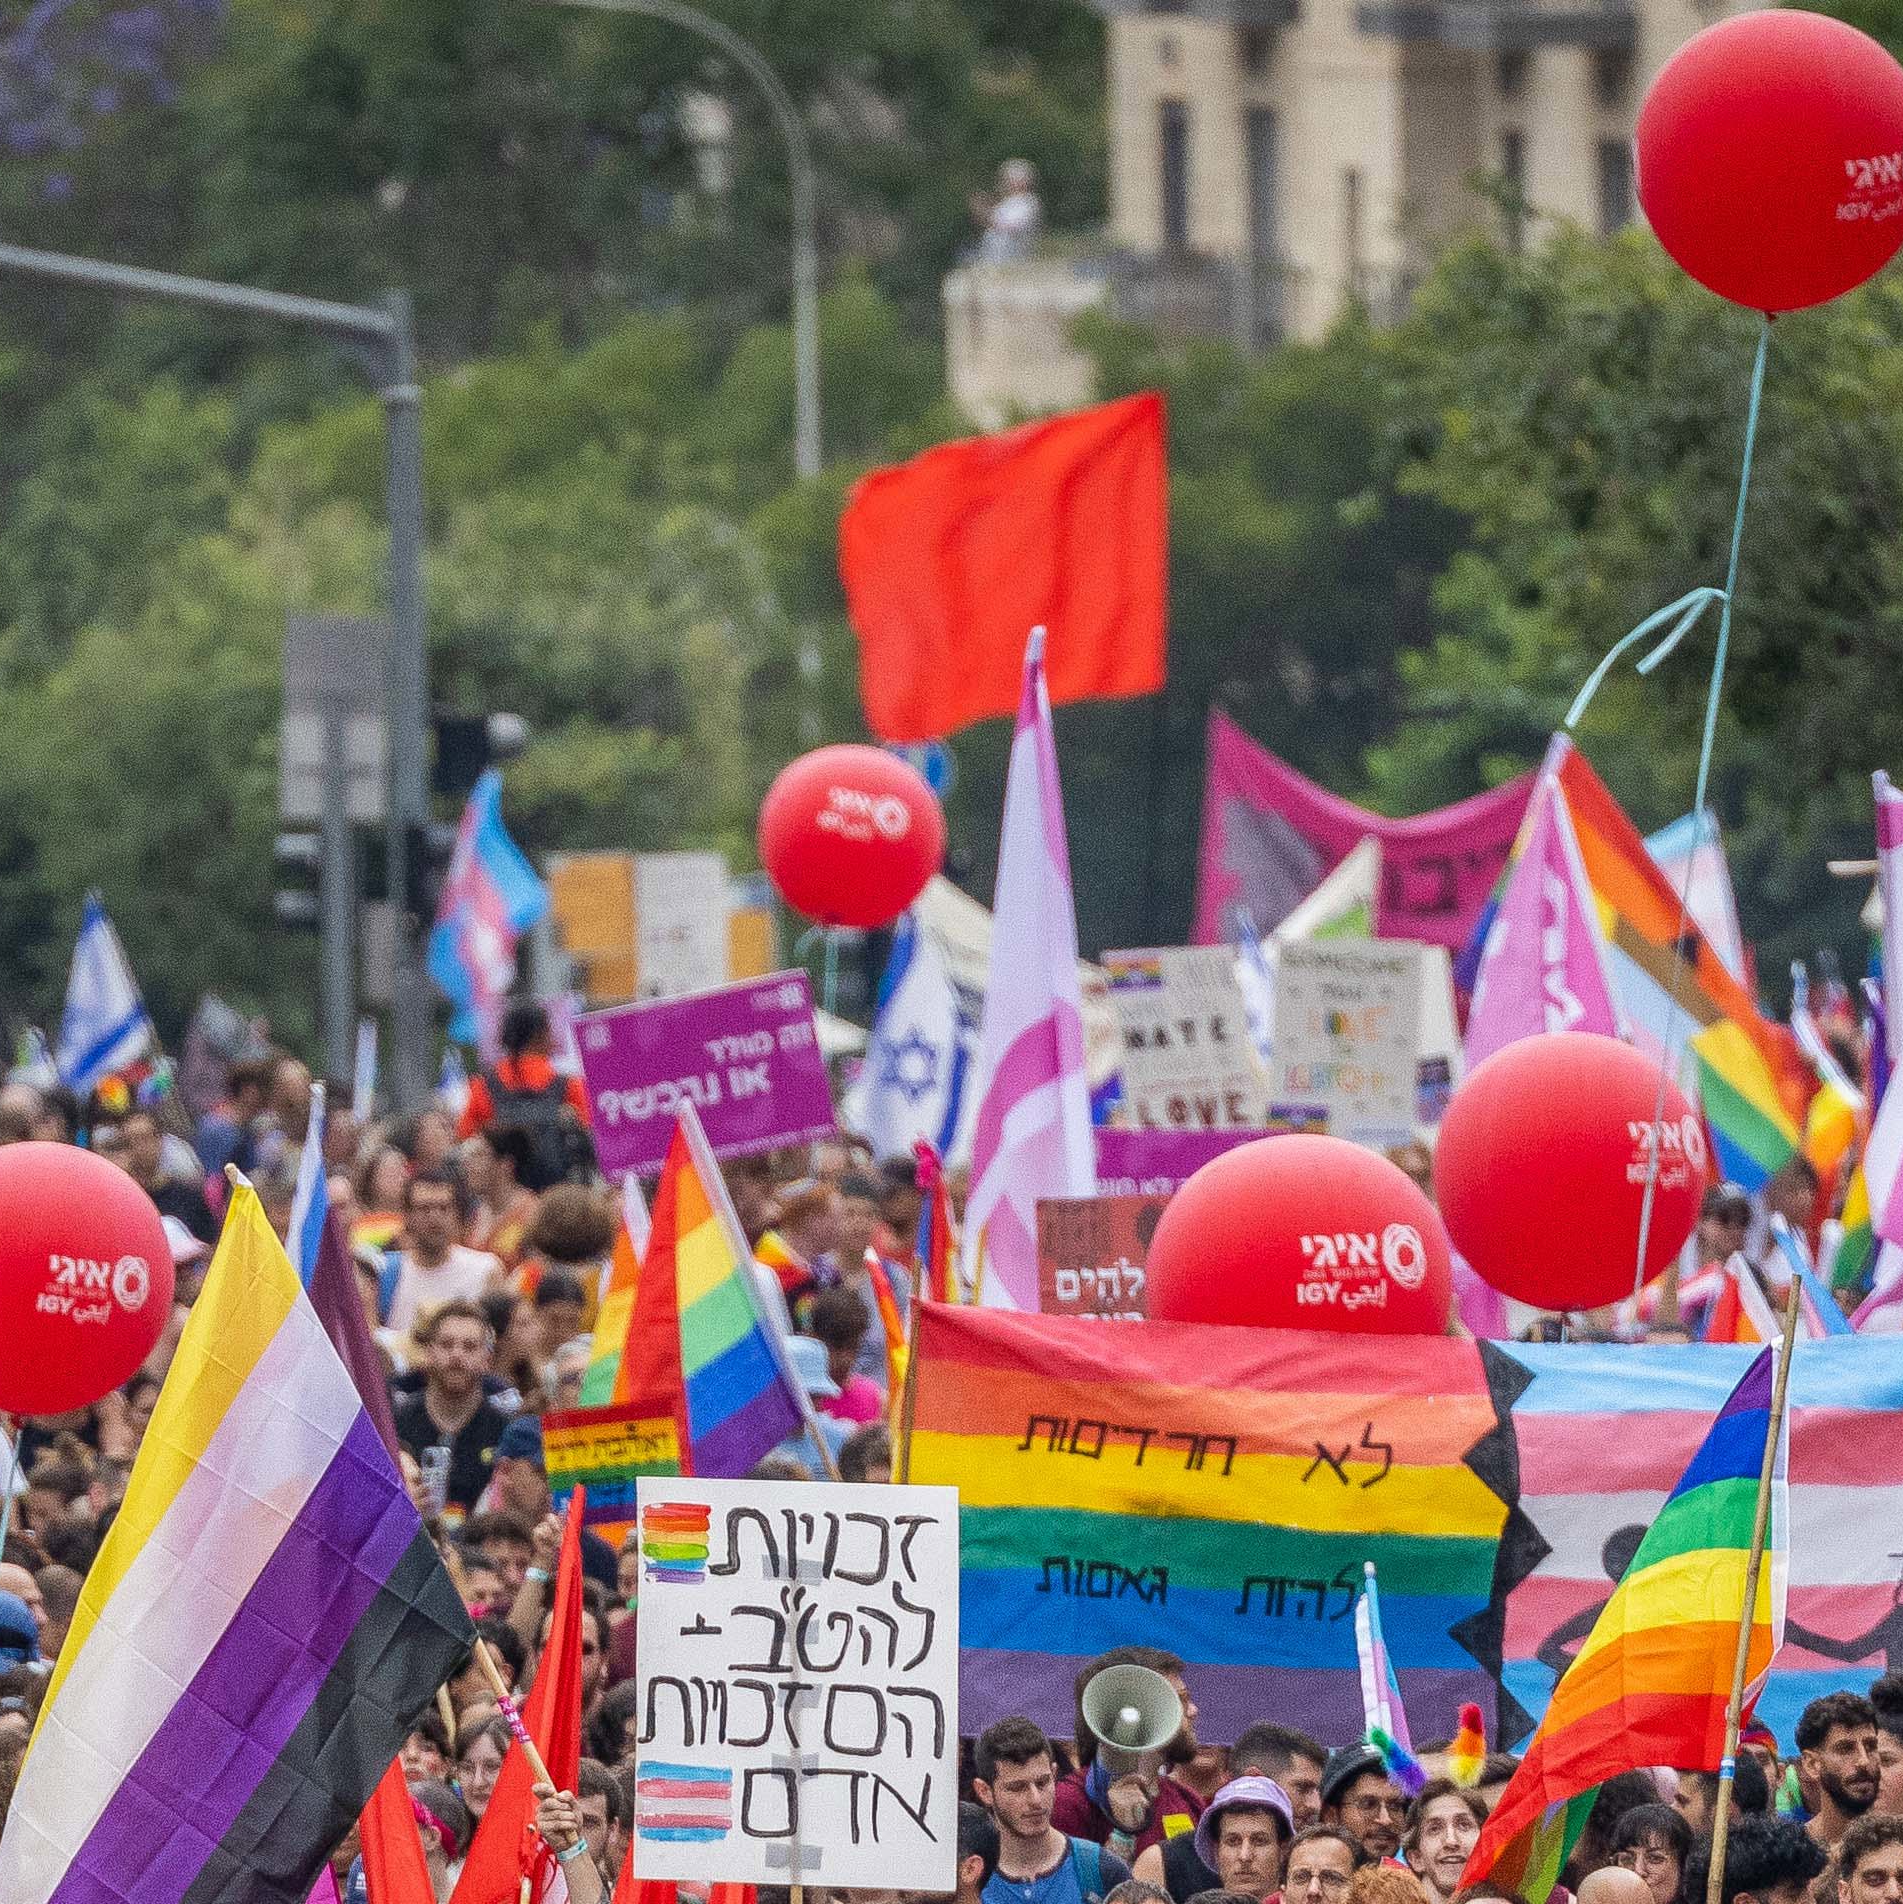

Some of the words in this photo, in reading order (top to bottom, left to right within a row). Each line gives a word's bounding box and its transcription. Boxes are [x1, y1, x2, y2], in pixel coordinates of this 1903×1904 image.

[1844, 153, 1902, 187] איגי
[49, 1254, 111, 1288] איגי
[1300, 1233, 1378, 1268] איגי
[36, 1293, 74, 1315] IGY
[1296, 1281, 1341, 1305] IGY
[1300, 1421, 1393, 1490] לא
[709, 1508, 940, 1584] זכויות
[637, 1677, 814, 1751] זכויות
[824, 1684, 946, 1759] הם
[741, 1768, 938, 1844] אדם
